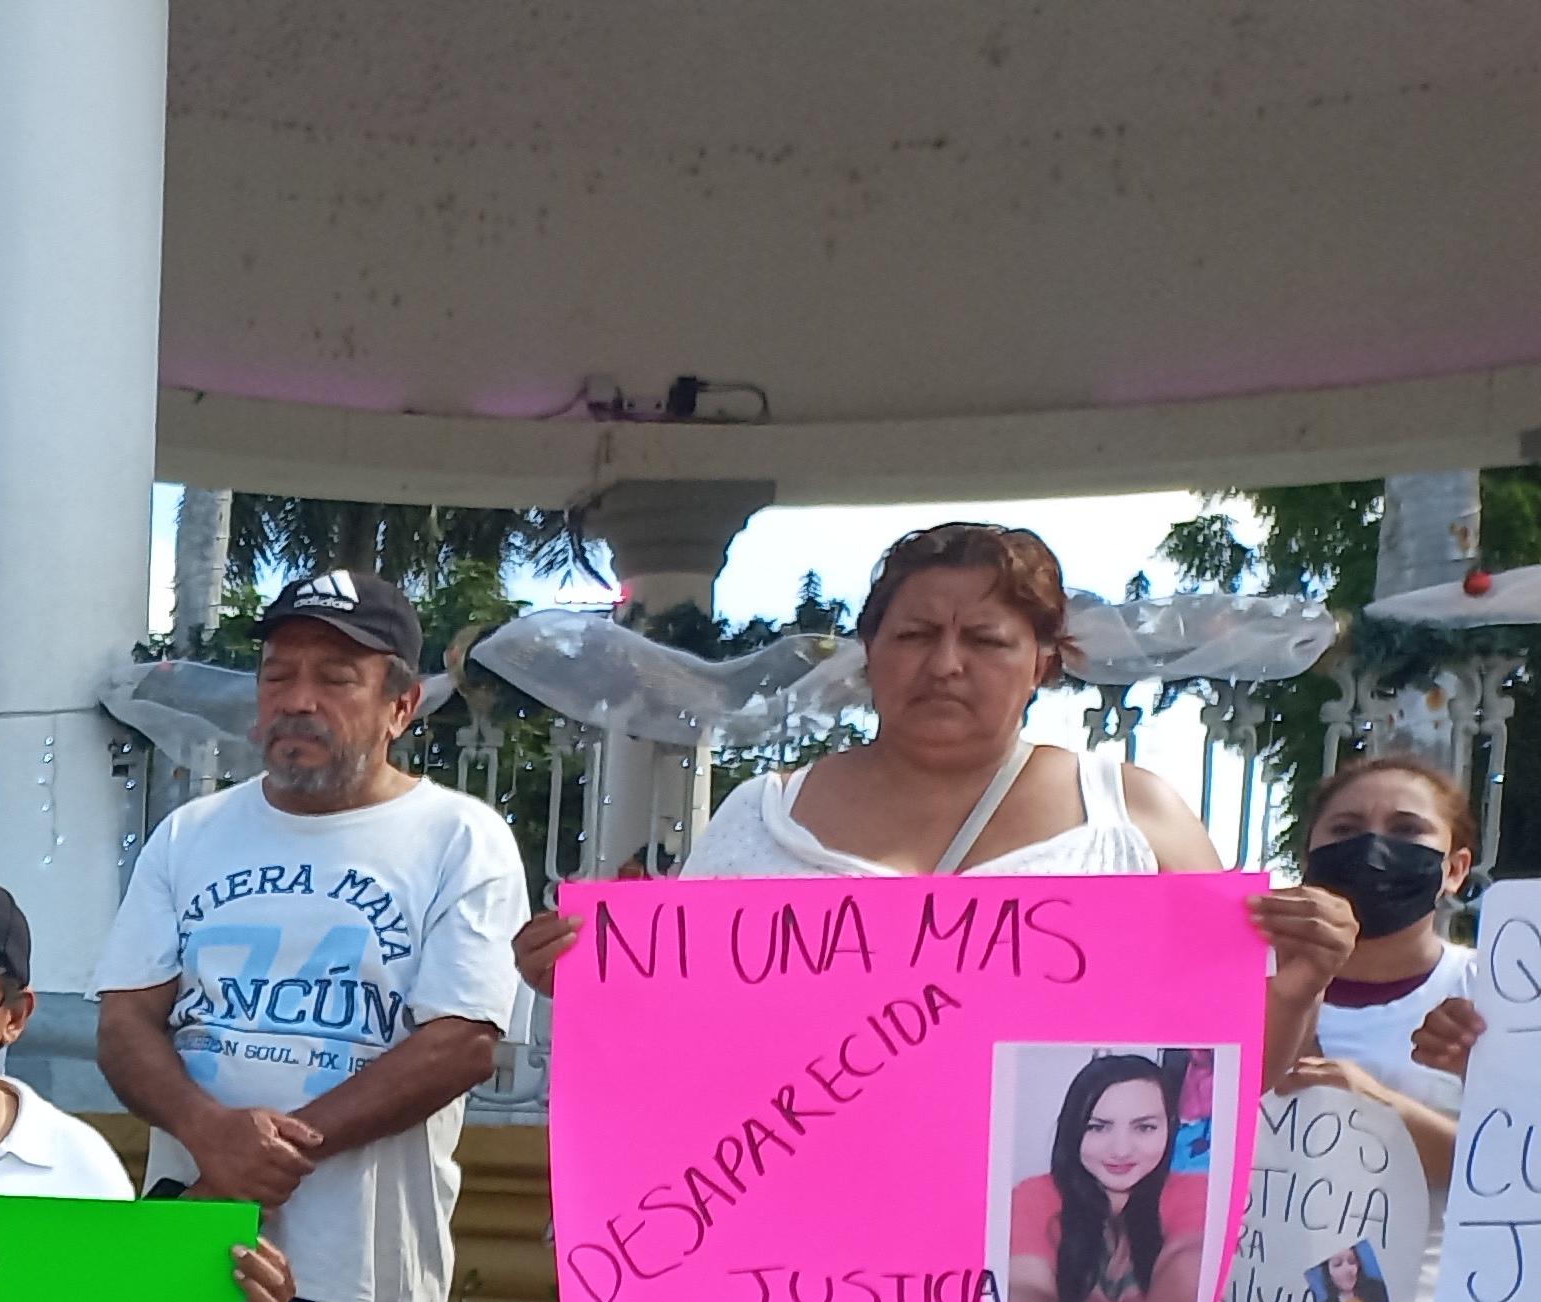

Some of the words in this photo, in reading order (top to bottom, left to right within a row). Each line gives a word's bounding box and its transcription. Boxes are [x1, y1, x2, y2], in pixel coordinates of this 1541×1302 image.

[327, 869, 412, 966] MAYA
[597, 897, 688, 983] NI
[731, 894, 876, 985] UNA
[910, 893, 1087, 984] MAS
[244, 1044, 299, 1065] SOUL
[307, 1048, 339, 1070] MX
